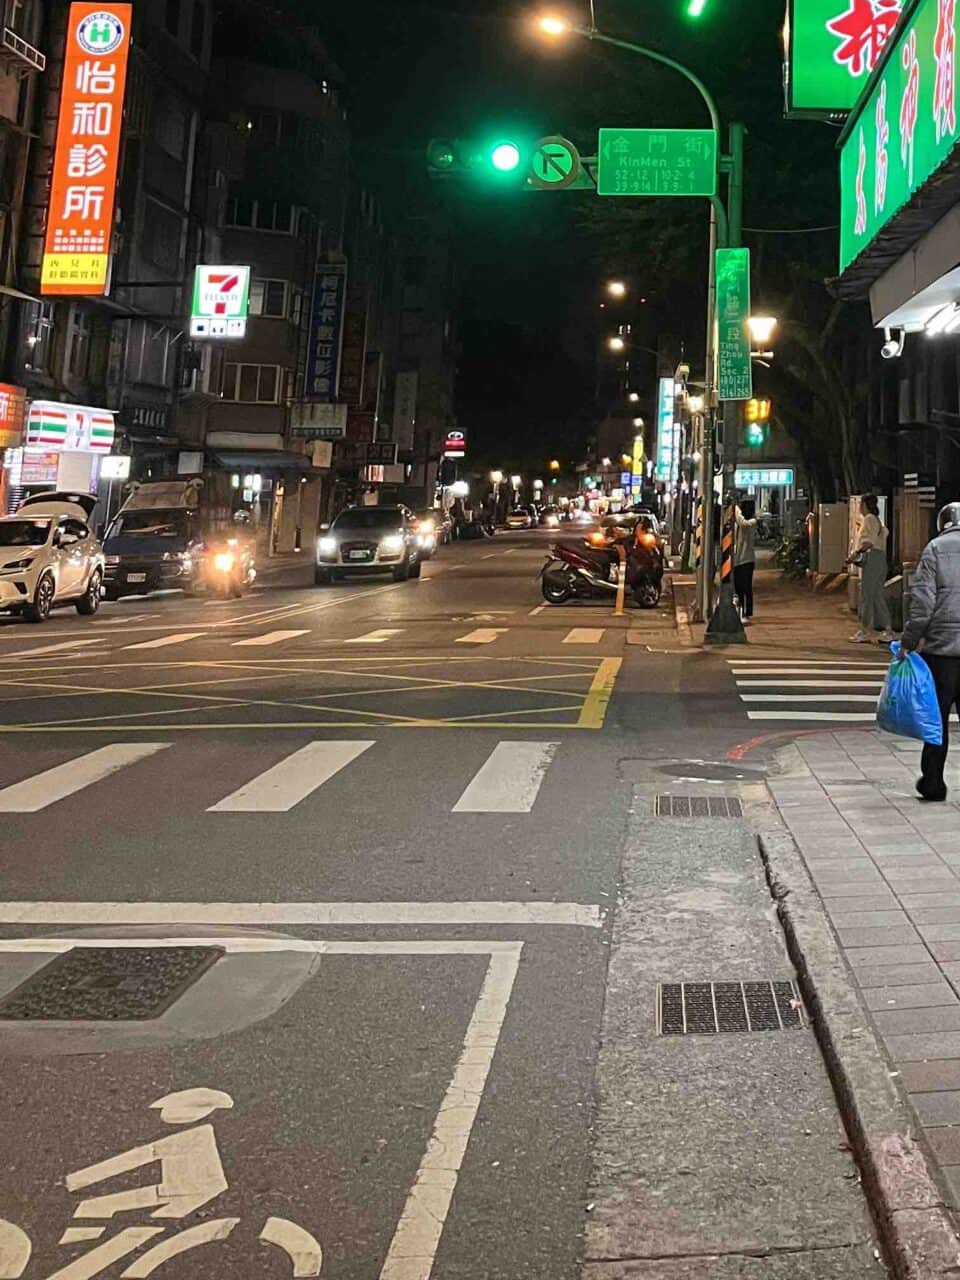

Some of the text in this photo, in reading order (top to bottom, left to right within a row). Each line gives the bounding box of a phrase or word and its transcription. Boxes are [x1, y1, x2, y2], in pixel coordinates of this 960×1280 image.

[62, 60, 116, 220] 怡和診所
[612, 135, 703, 154] 金門街
